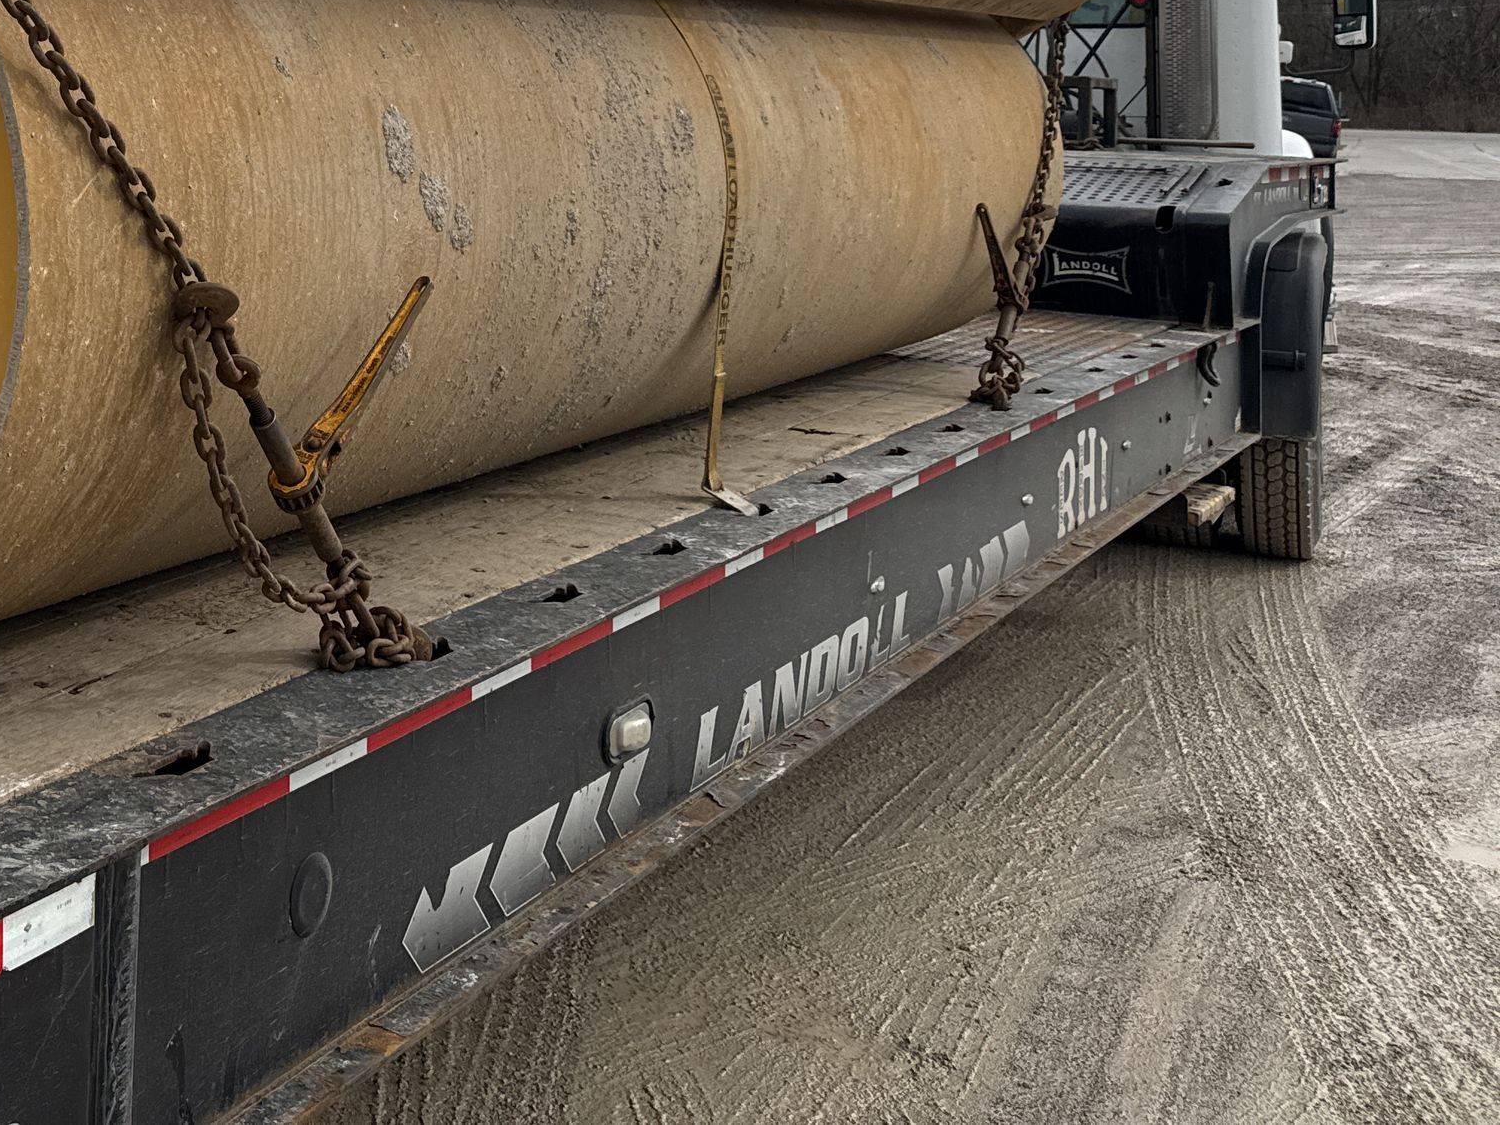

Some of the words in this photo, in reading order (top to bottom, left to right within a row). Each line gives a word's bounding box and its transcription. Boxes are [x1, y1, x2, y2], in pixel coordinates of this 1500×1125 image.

[727, 164, 738, 231] LOAD
[718, 236, 736, 347] HUGGER
[1053, 252, 1119, 281] LANDOLL
[689, 590, 912, 793] LANDOLL
